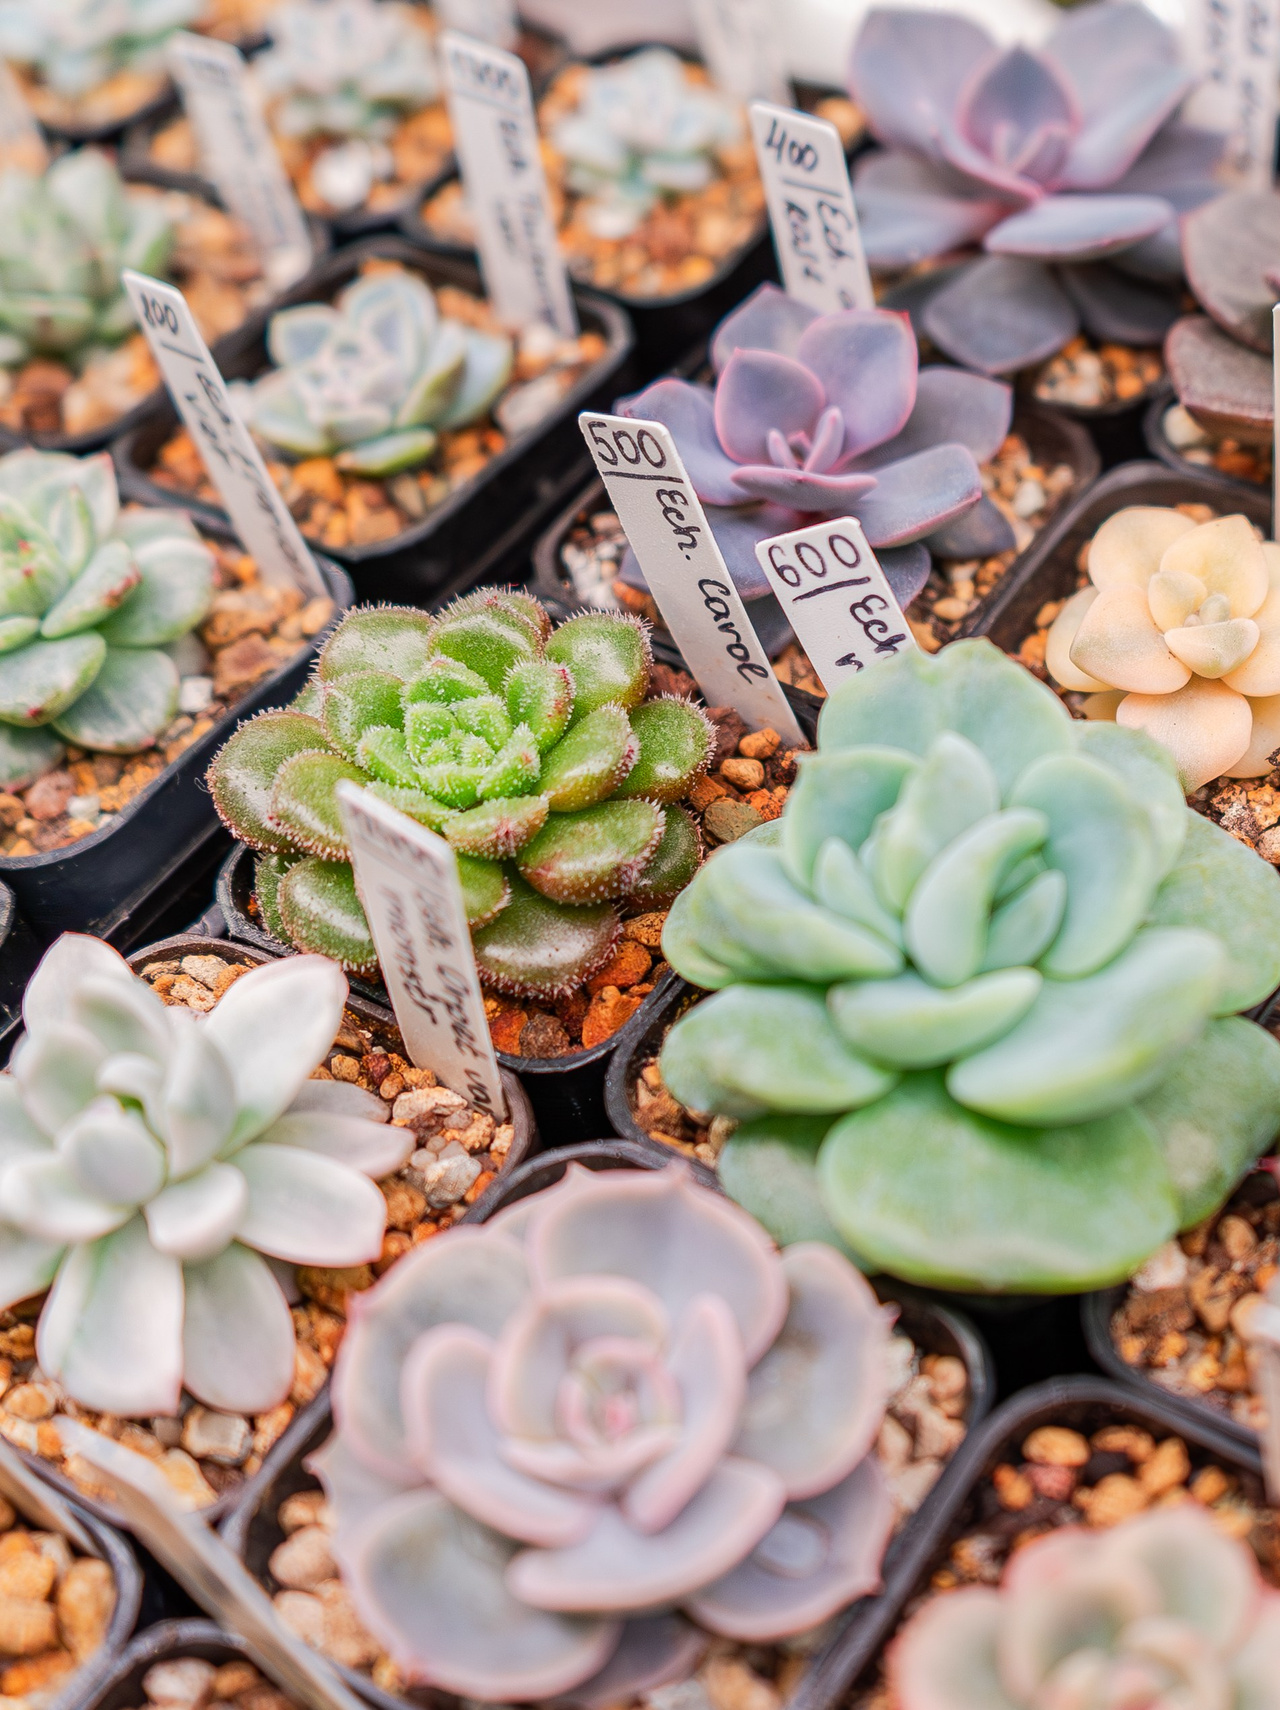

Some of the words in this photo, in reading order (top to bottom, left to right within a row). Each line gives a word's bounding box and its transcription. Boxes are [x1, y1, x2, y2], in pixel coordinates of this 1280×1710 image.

[766, 117, 819, 172] 400
[588, 421, 667, 468] 500
[656, 488, 700, 560] Ech.
[698, 578, 769, 685] Carol
[768, 534, 860, 587] 600
